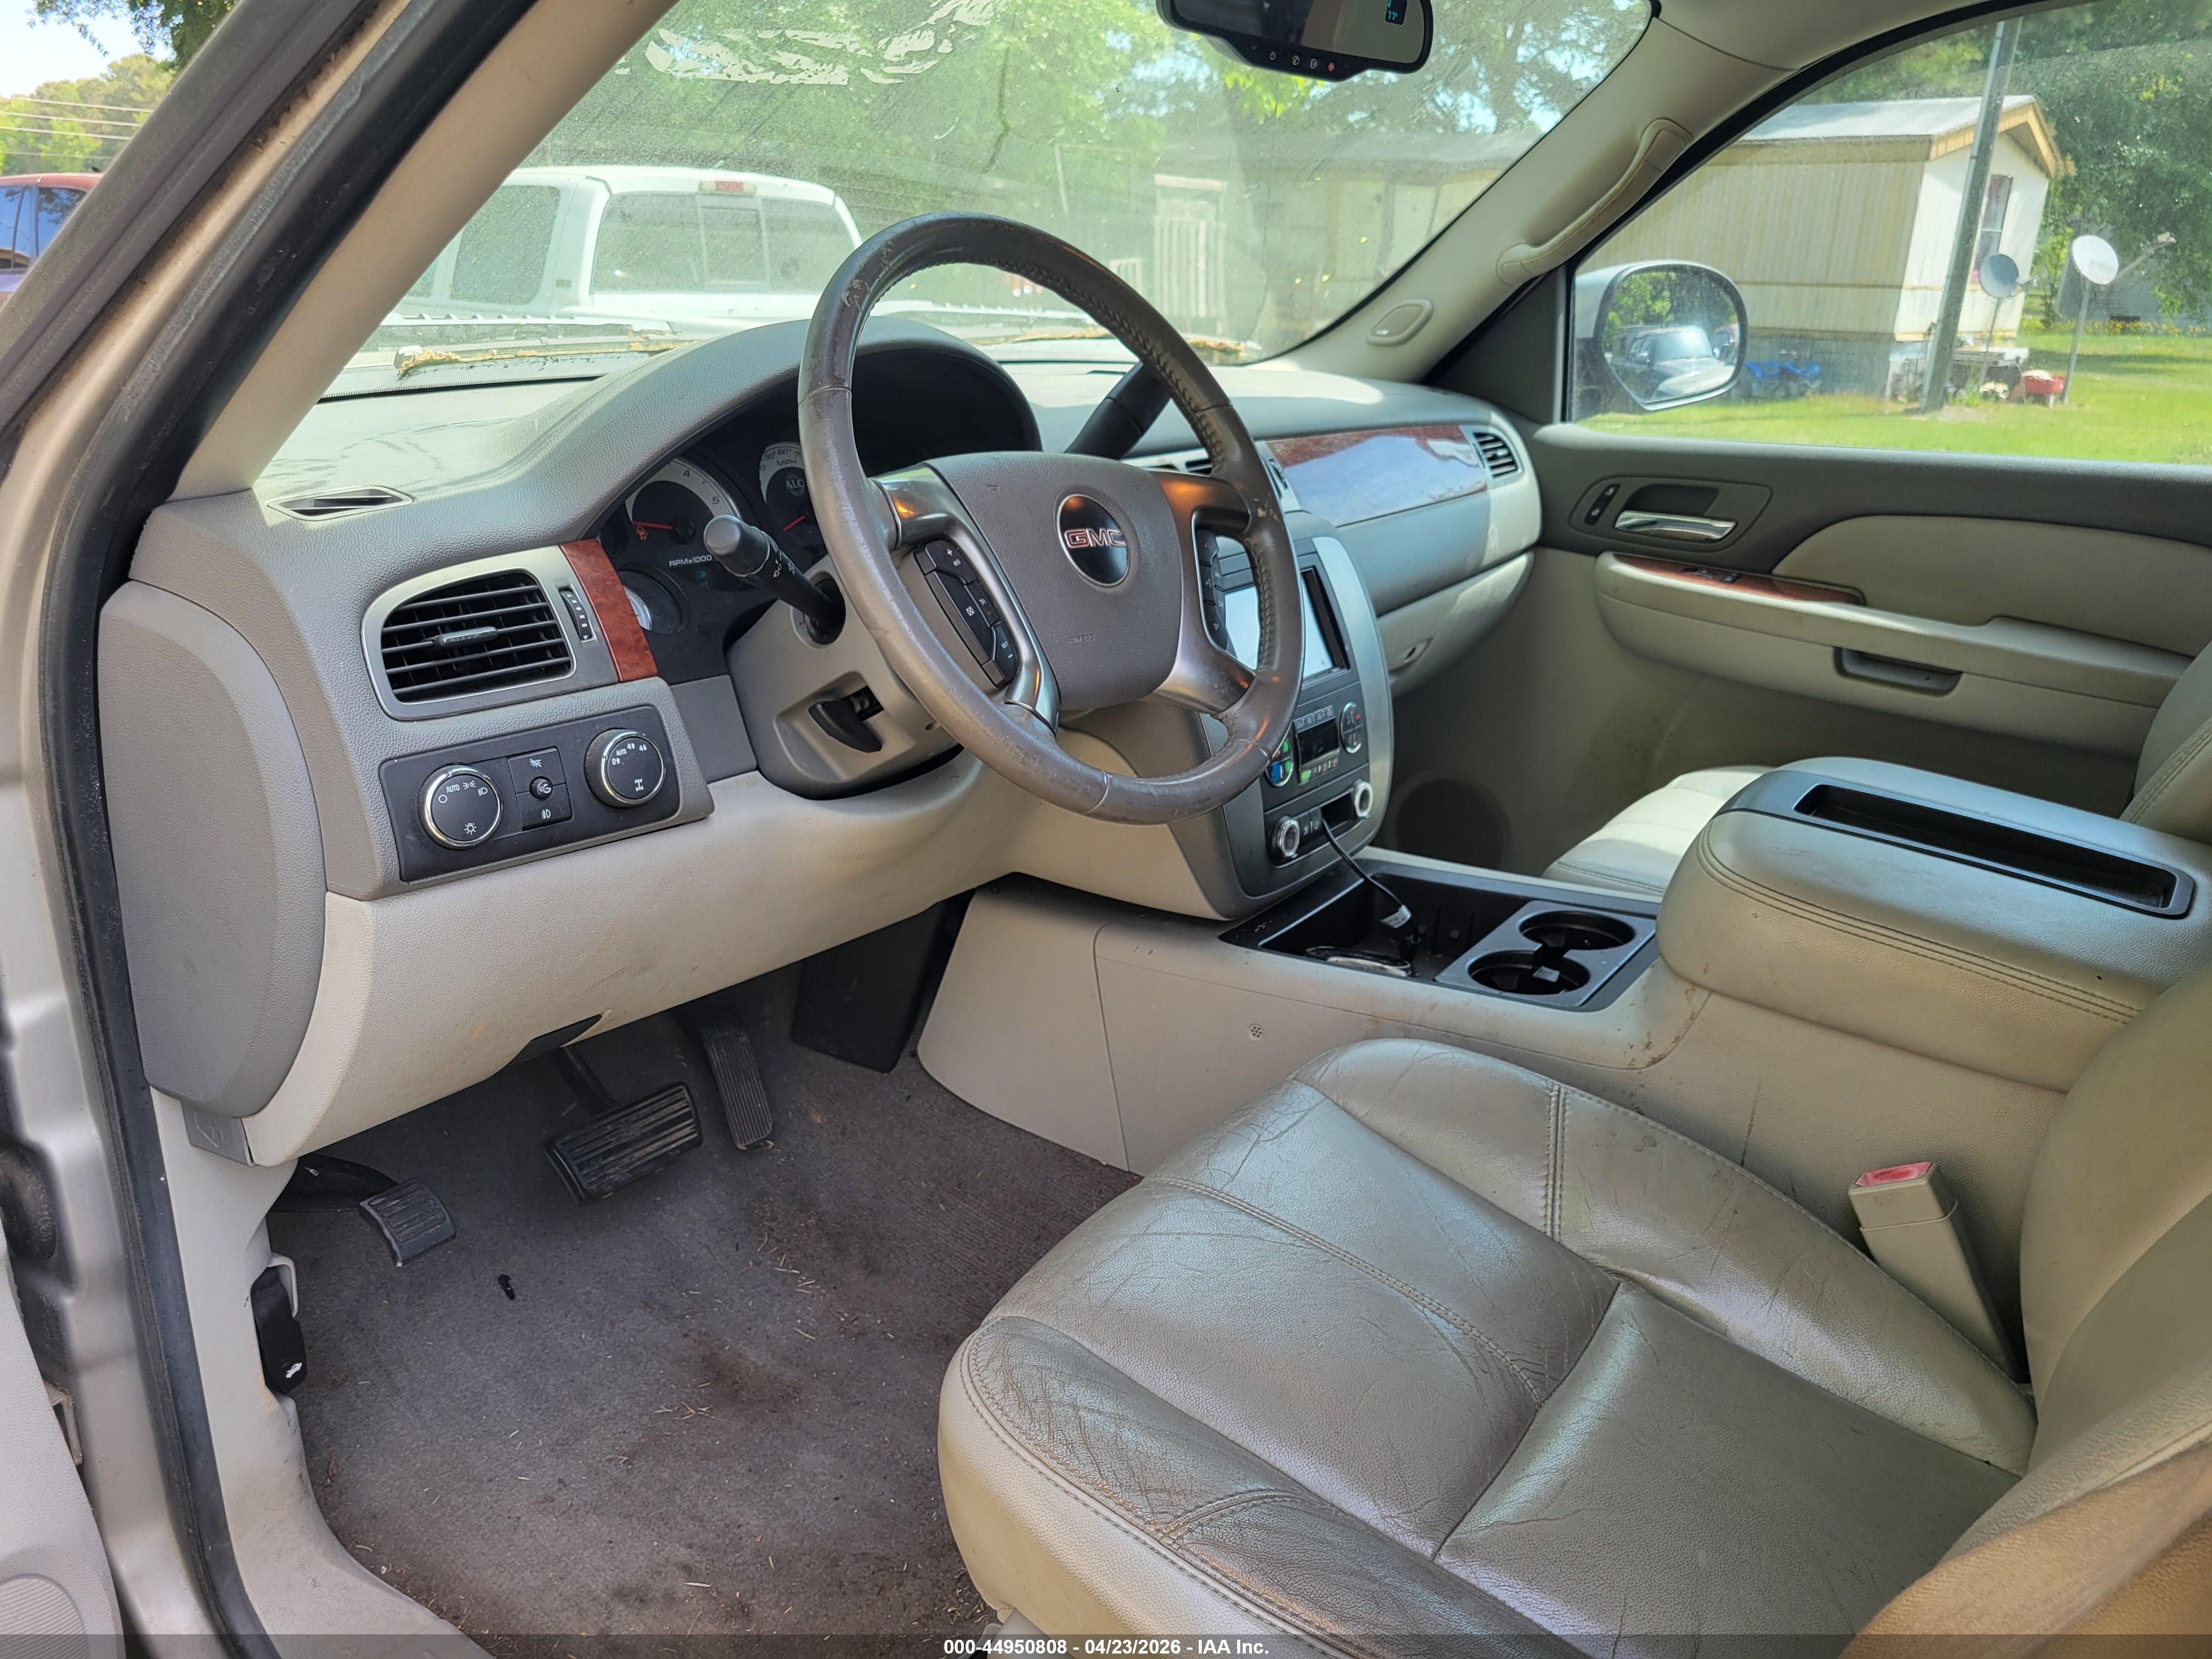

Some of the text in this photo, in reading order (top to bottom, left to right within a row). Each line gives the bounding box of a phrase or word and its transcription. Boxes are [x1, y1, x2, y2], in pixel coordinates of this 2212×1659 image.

[777, 459, 798, 467] MPH
[683, 470, 690, 478] 4
[713, 496, 720, 505] 5
[1064, 528, 1127, 549] GMC
[669, 555, 713, 568] RPMx1000
[616, 748, 627, 757] AUTO
[446, 784, 460, 793] AUTO
